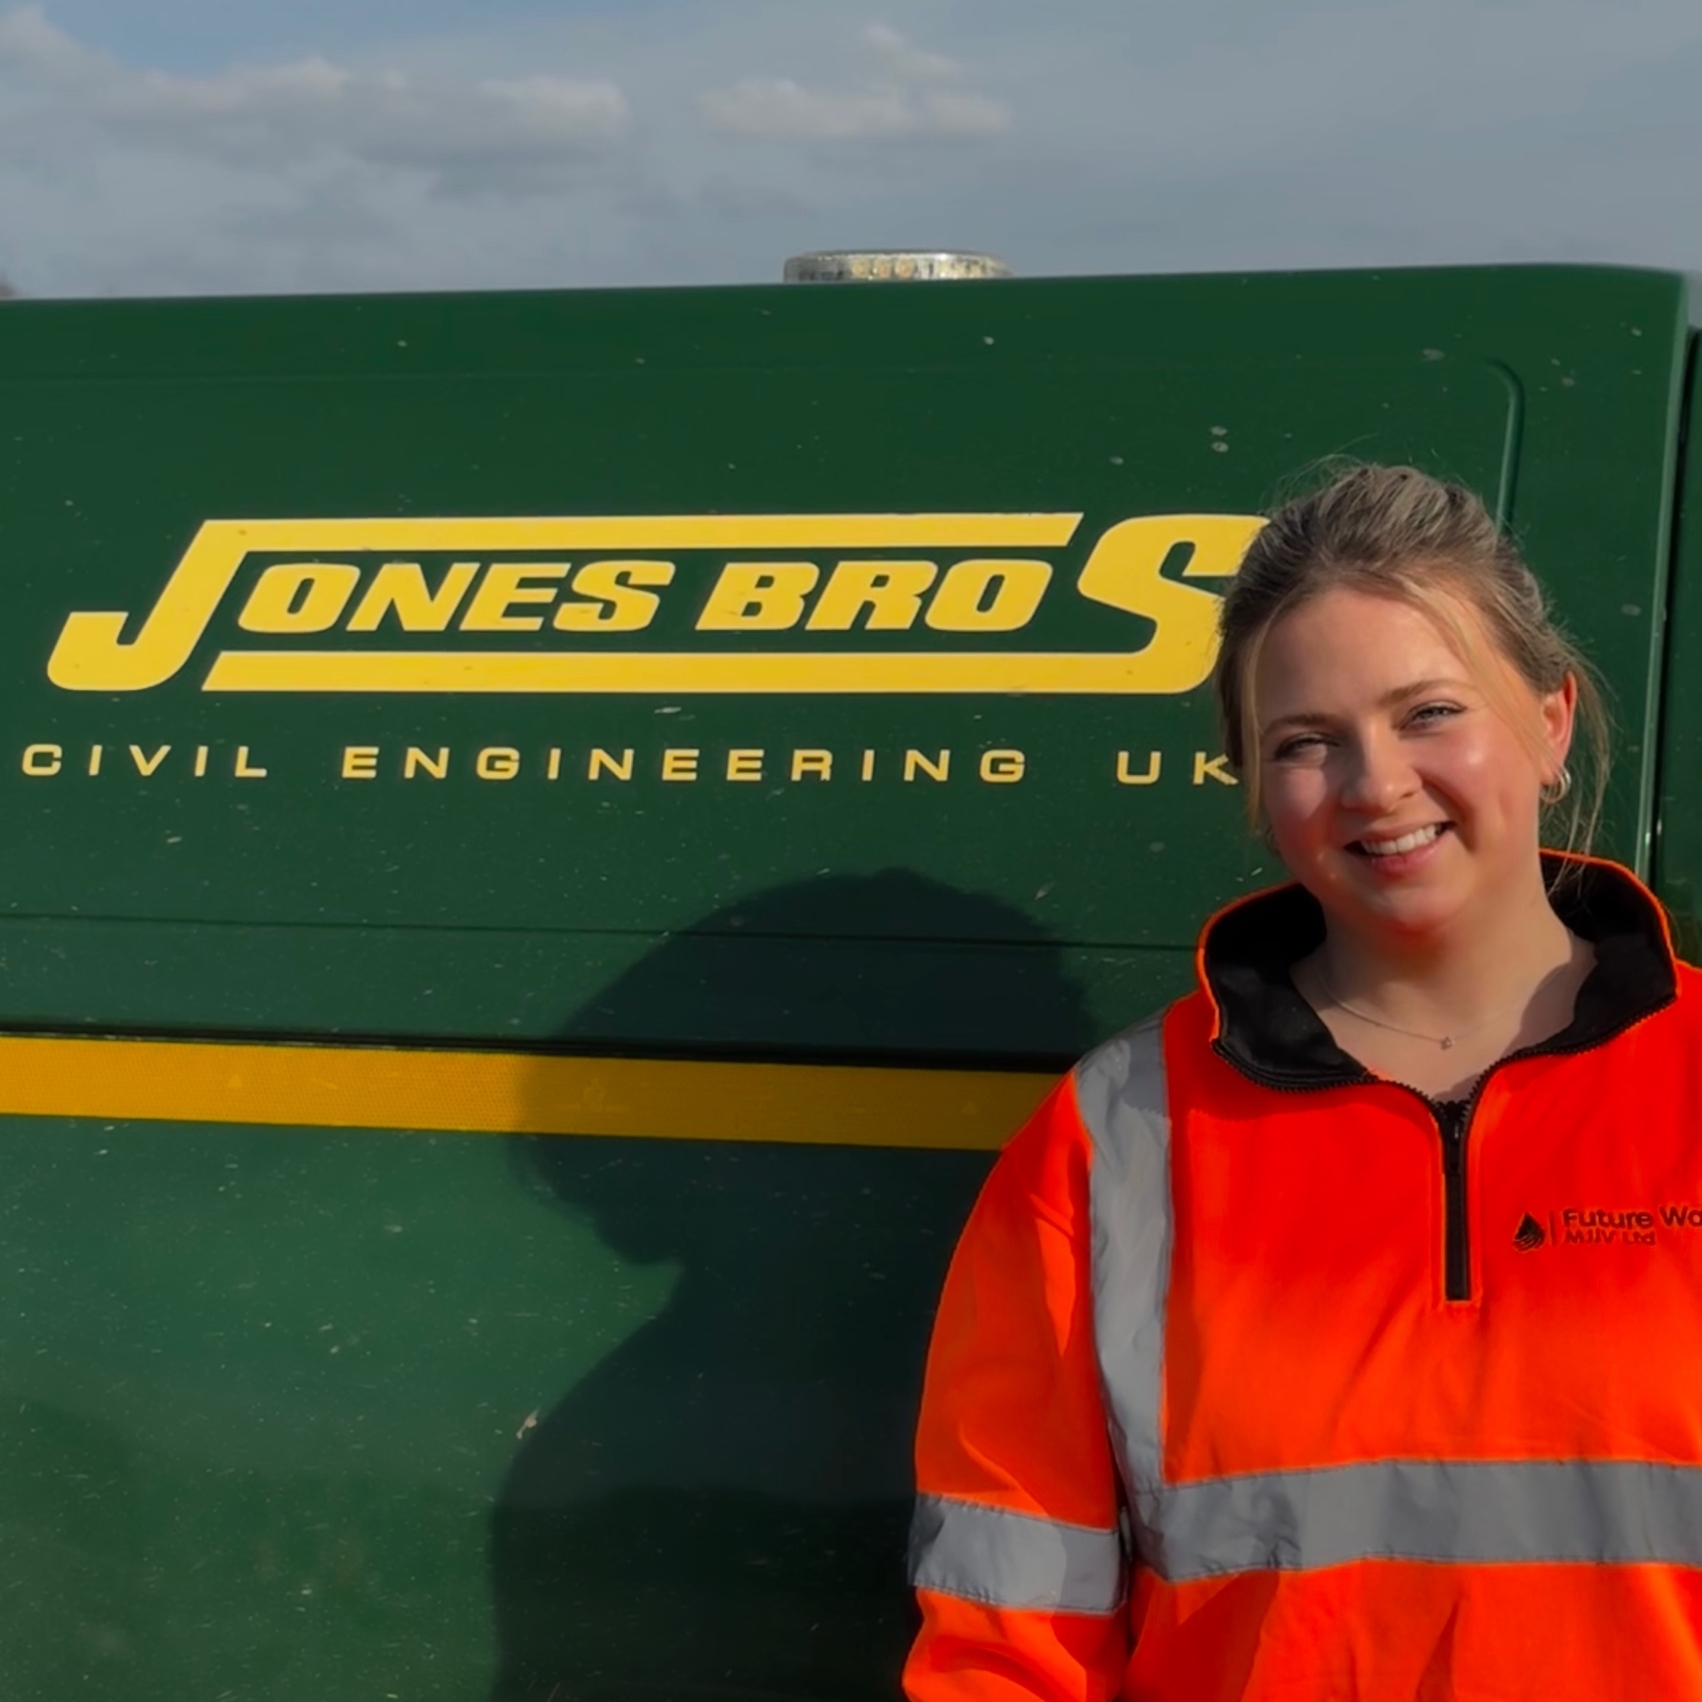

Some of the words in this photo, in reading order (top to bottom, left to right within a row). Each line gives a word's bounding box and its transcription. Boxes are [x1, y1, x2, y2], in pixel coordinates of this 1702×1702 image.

[46, 517, 676, 693] JONES
[694, 513, 1271, 695] BROS
[20, 743, 268, 779] CIVIL
[341, 746, 1026, 783] ENGINEERING
[1116, 750, 1239, 786] UK
[1562, 1208, 1654, 1229] Future
[1622, 1230, 1656, 1246] Ltd
